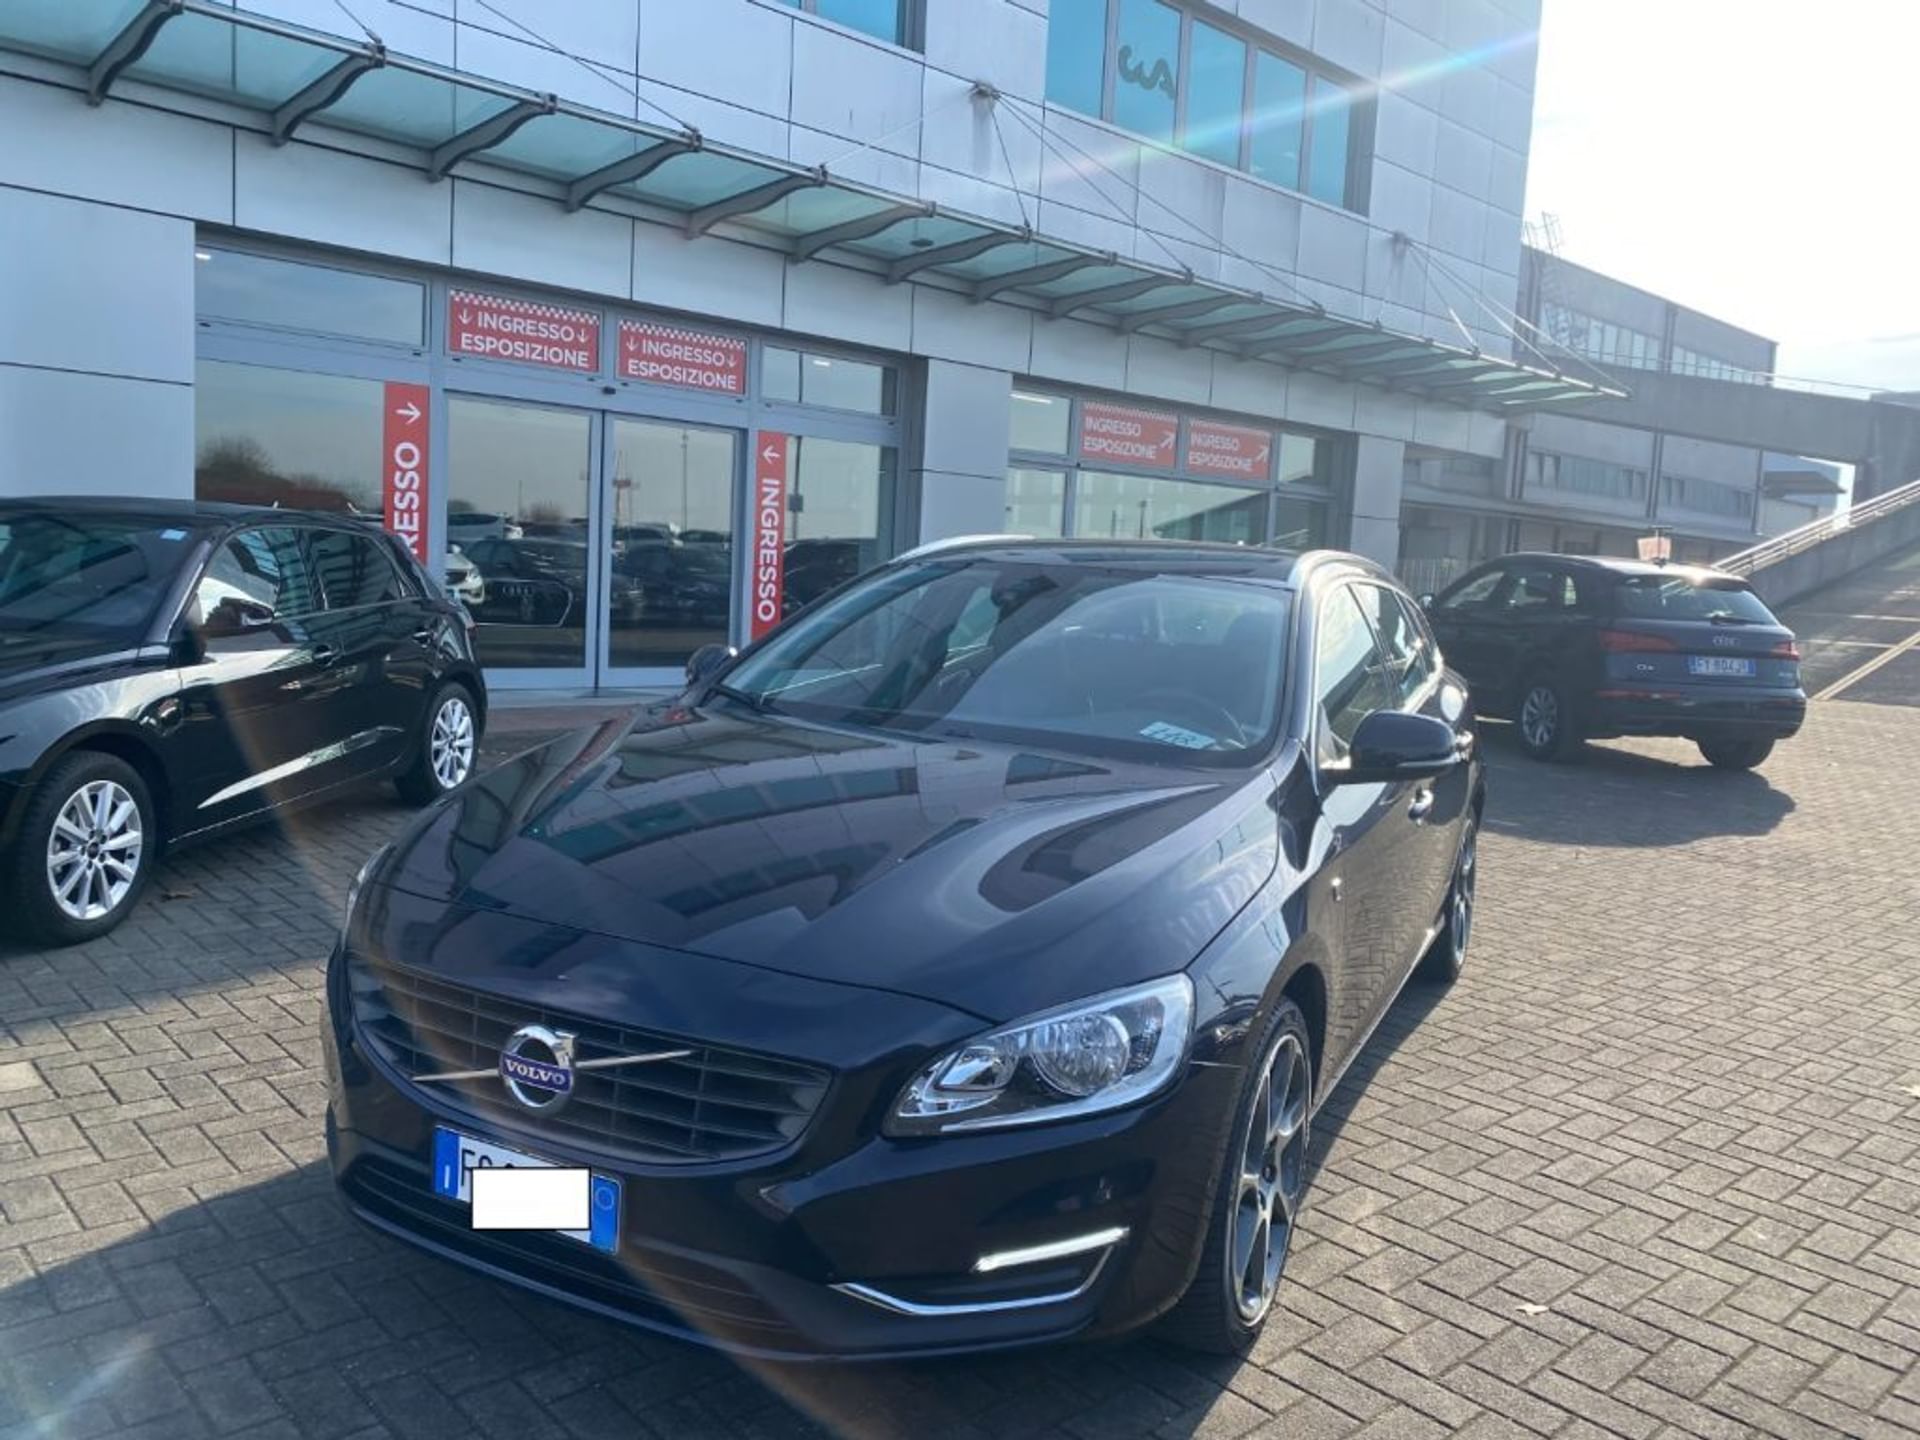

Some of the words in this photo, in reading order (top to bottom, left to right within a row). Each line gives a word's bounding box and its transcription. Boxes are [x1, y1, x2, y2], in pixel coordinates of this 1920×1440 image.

[478, 310, 576, 342] INGRESSO
[461, 332, 589, 368] ESPOSIZIONE
[642, 338, 726, 368] INGRESSO
[627, 358, 737, 390] ESPOSIZIONE
[1085, 416, 1141, 437] INGRESSO
[1083, 436, 1156, 459] ESPOSIZIONE
[1191, 432, 1240, 452] INGRESSO
[1188, 452, 1252, 472] ESPOSIZIONE
[757, 478, 780, 621] INGRESSO
[505, 1058, 566, 1086] VOLVO
